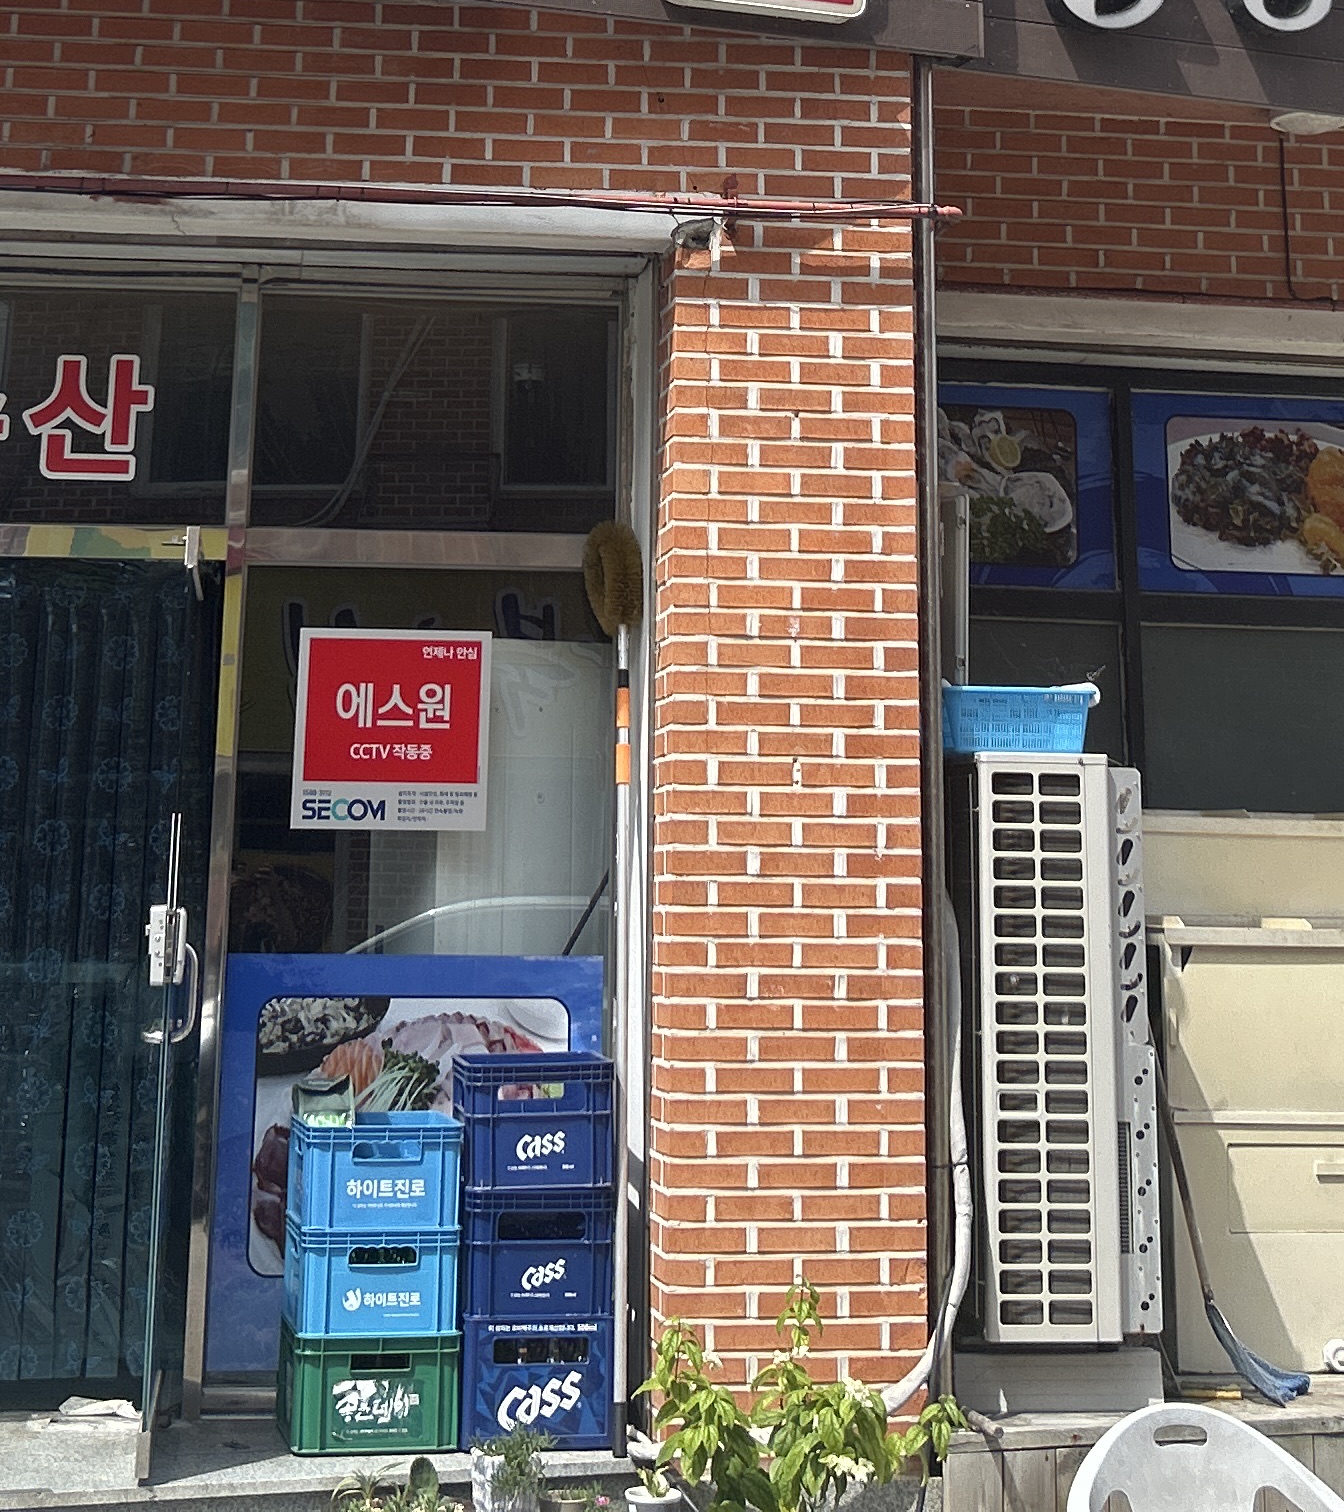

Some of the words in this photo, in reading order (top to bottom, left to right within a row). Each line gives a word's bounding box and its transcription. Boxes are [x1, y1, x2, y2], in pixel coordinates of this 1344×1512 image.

[422, 646, 454, 659] 언제나
[456, 646, 478, 660] 안심
[336, 682, 452, 730] 에스원
[350, 743, 390, 759] CCTV
[392, 744, 433, 761] 작동중
[301, 798, 386, 821] SECOM
[346, 1178, 425, 1199] 하이트진로
[363, 1292, 422, 1308] 하이트진로
